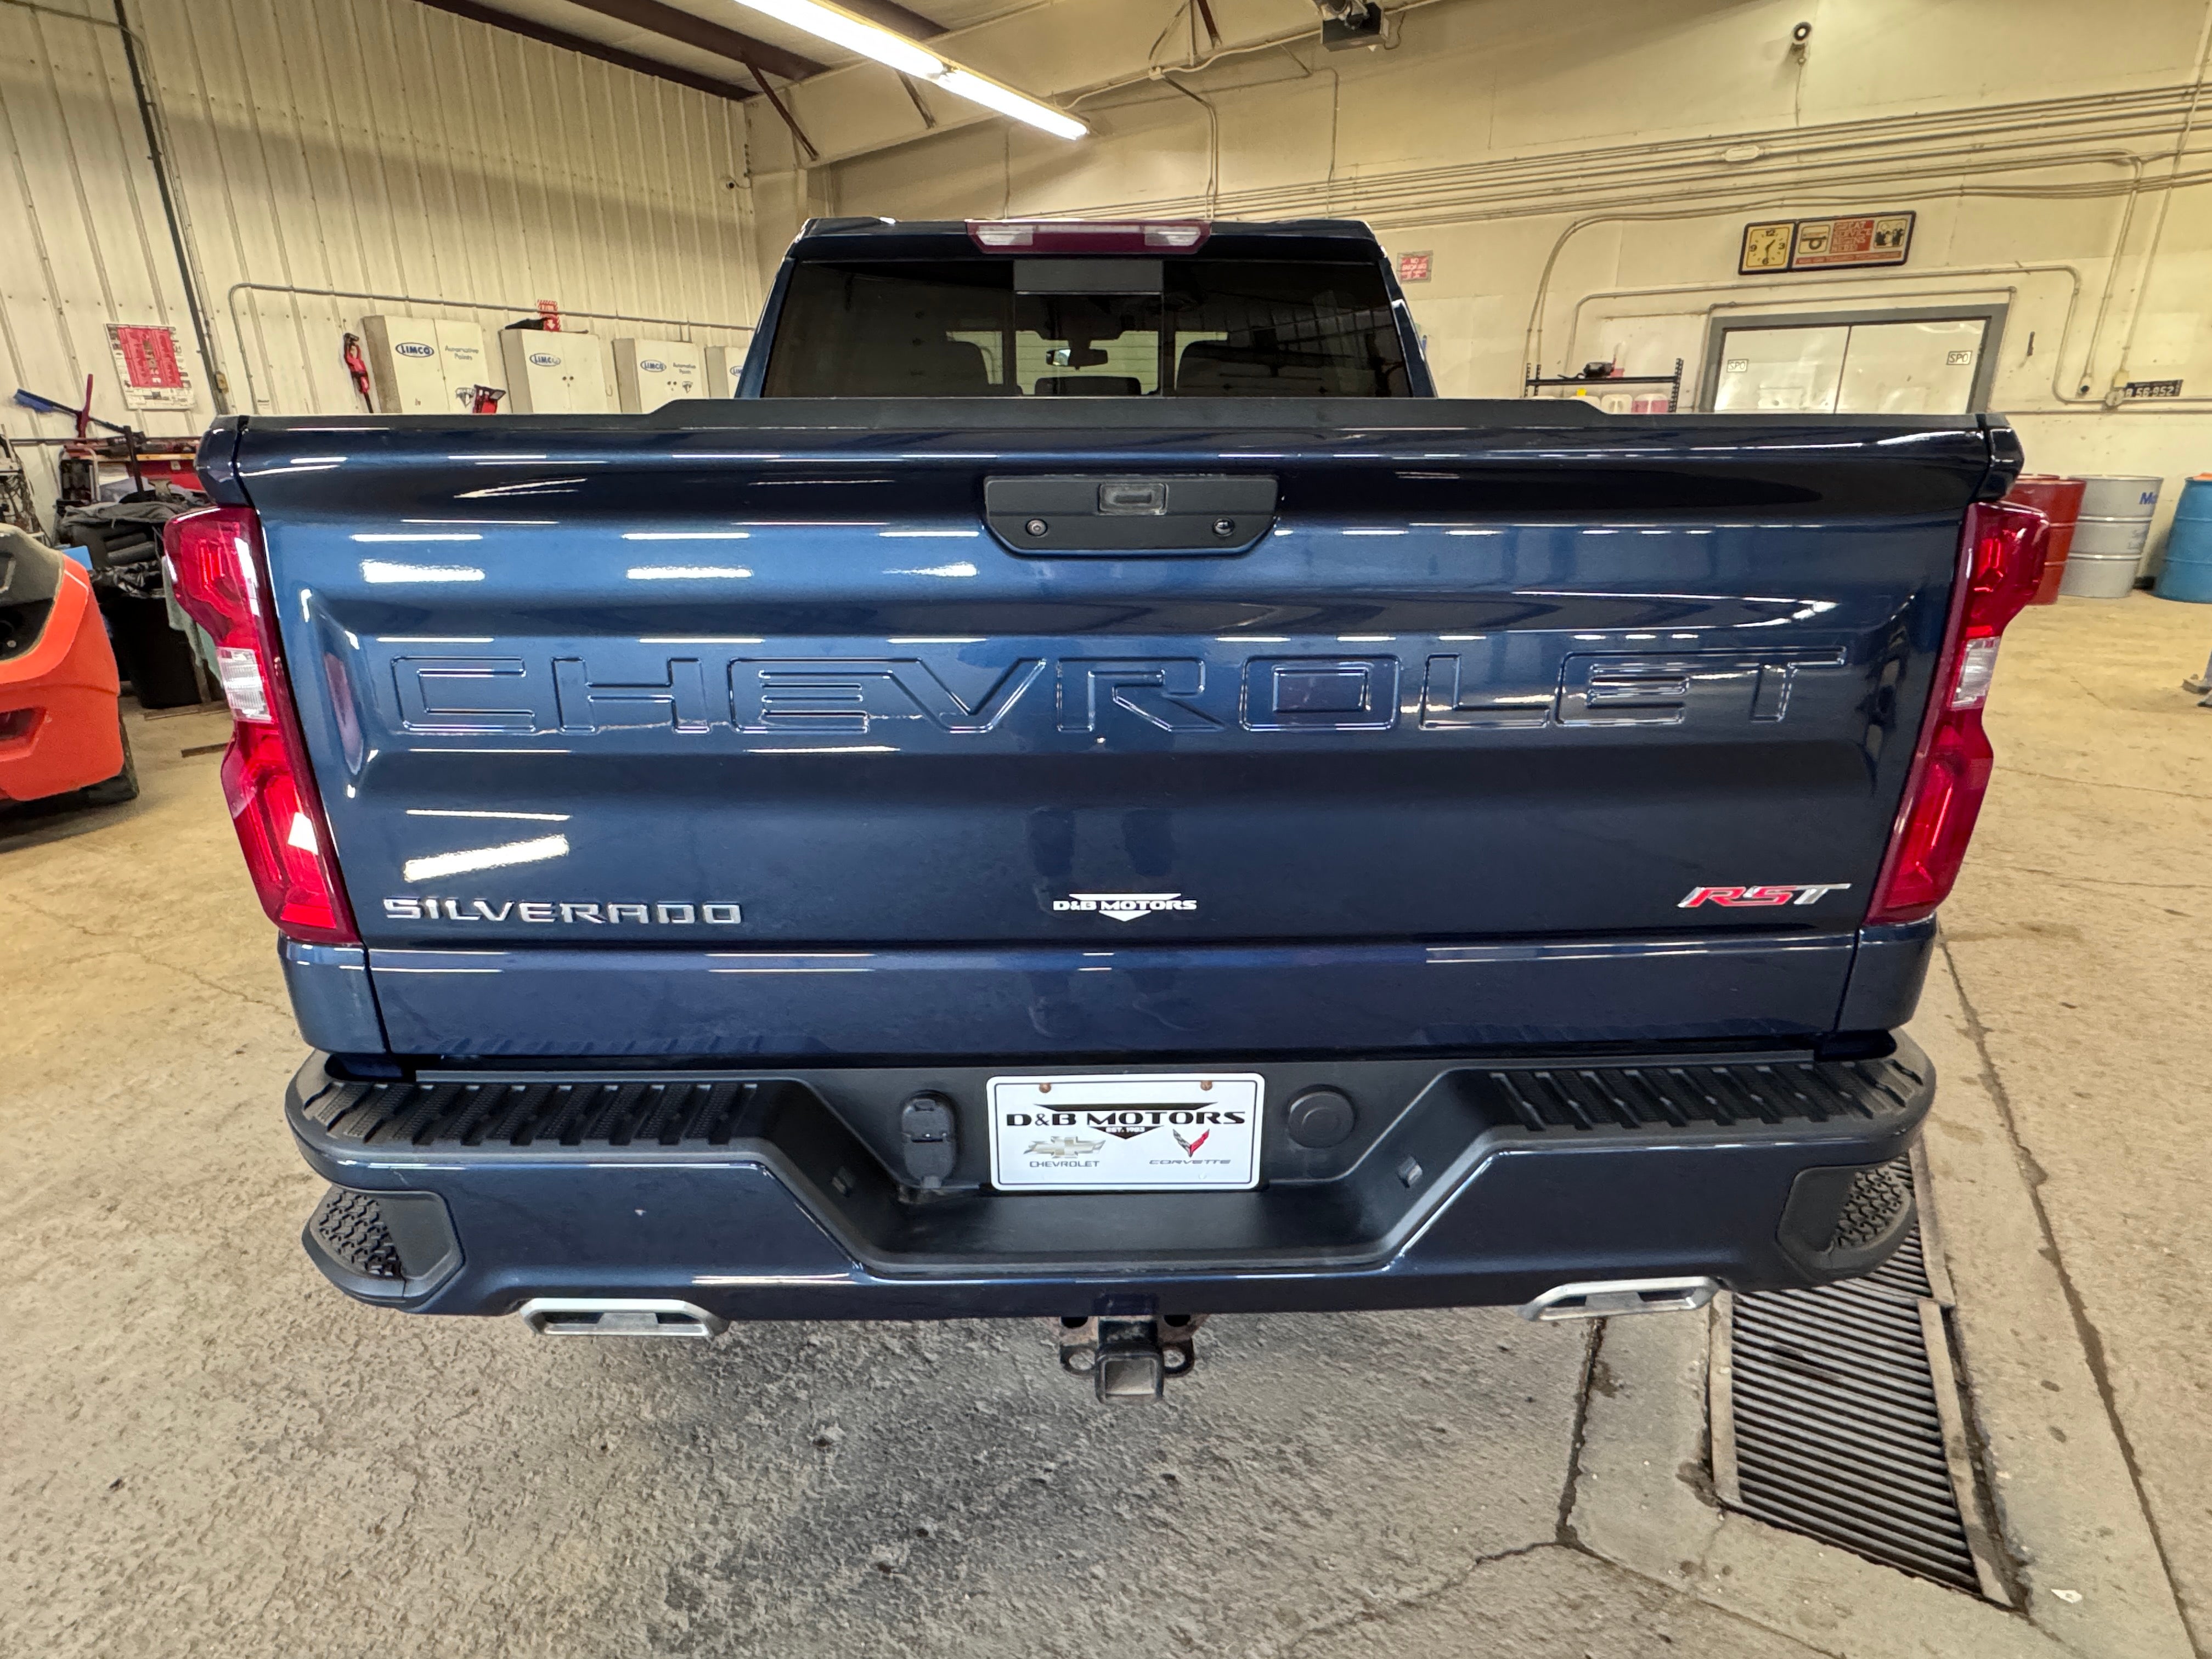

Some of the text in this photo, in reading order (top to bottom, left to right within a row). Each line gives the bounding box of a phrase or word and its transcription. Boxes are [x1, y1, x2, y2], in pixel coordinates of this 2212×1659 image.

[401, 345, 430, 355] LIMCO
[391, 646, 1847, 734] CHEVROLET
[1677, 883, 1852, 907] RST
[383, 897, 742, 924] SILVERADO
[1053, 900, 1197, 911] D&B MOTORS
[1006, 1111, 1246, 1126] D&B MOTORS
